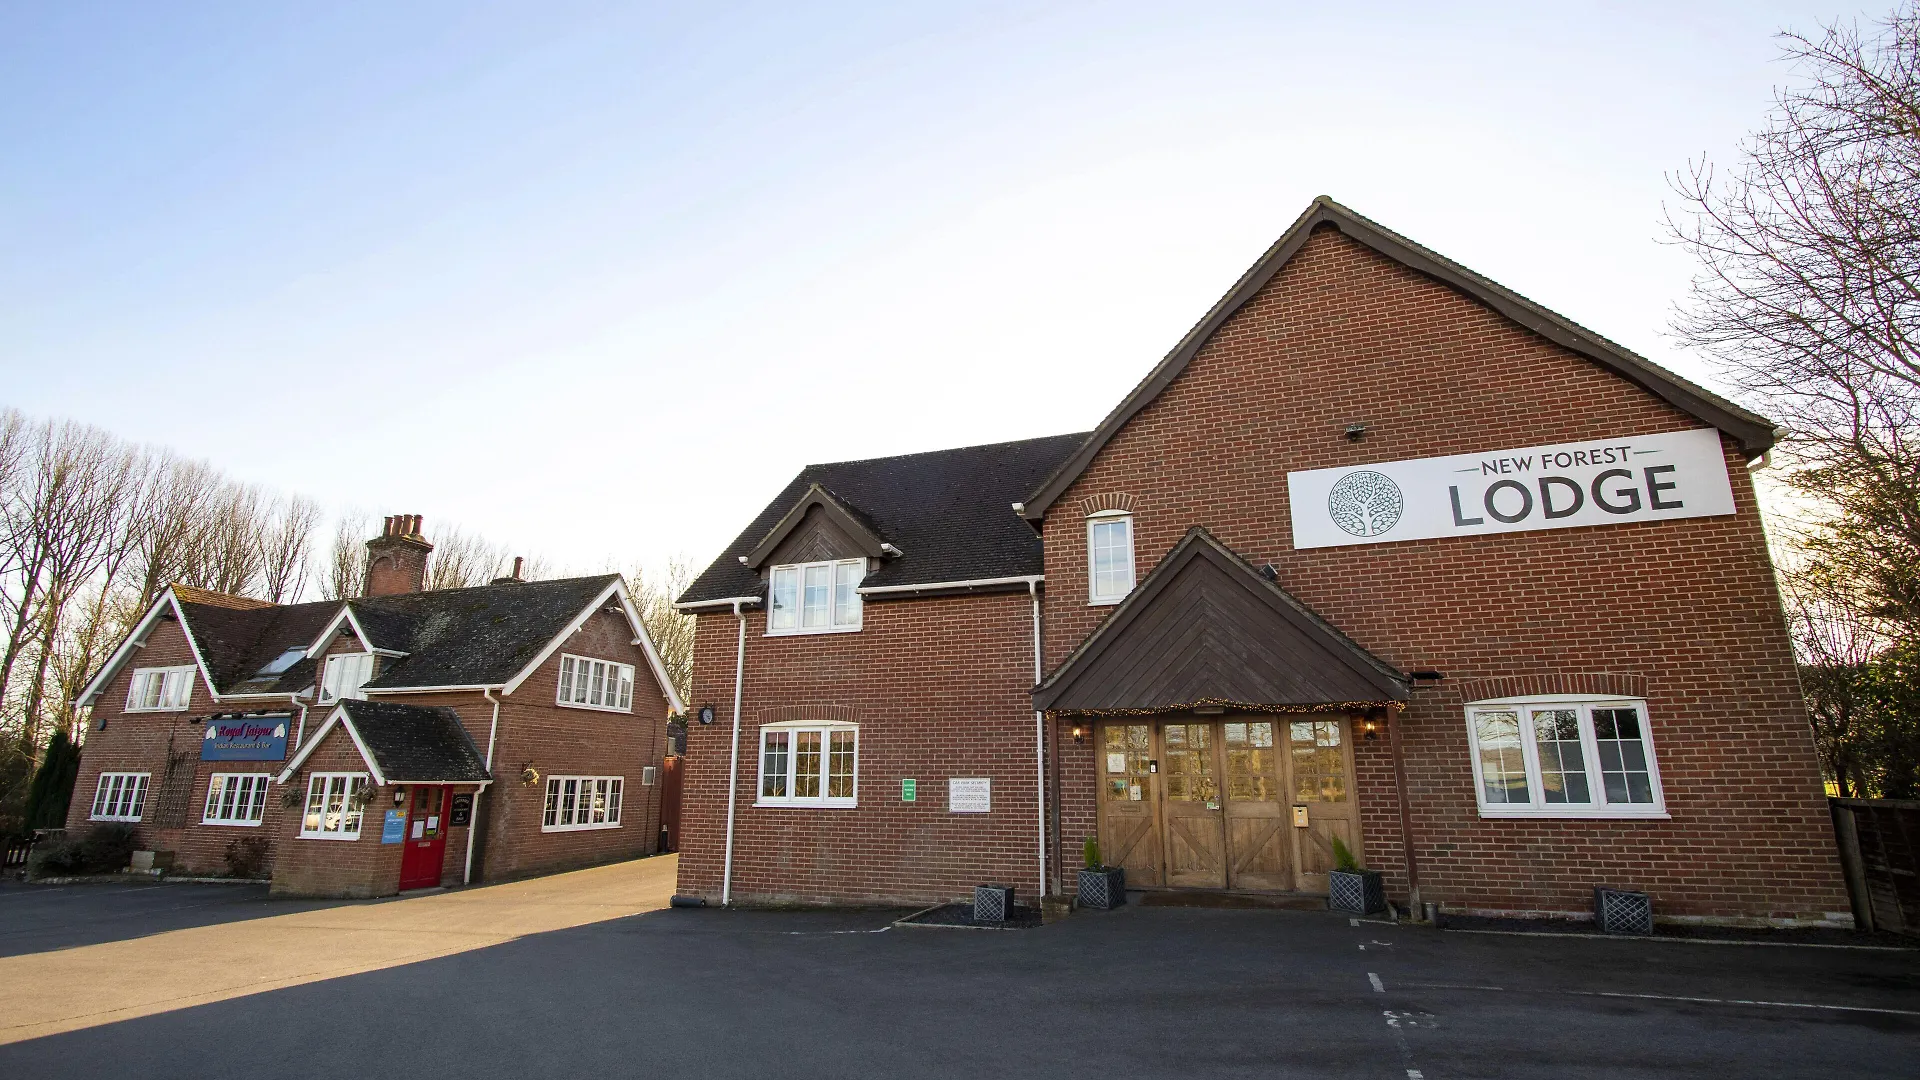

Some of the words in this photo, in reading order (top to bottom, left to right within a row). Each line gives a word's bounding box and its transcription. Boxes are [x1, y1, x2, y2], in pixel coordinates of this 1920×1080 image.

[1482, 455, 1533, 476] NEW
[1541, 446, 1632, 470] FOREST
[1449, 465, 1684, 527] LODGE
[218, 723, 247, 742] Royal
[243, 725, 274, 742] Jaipur
